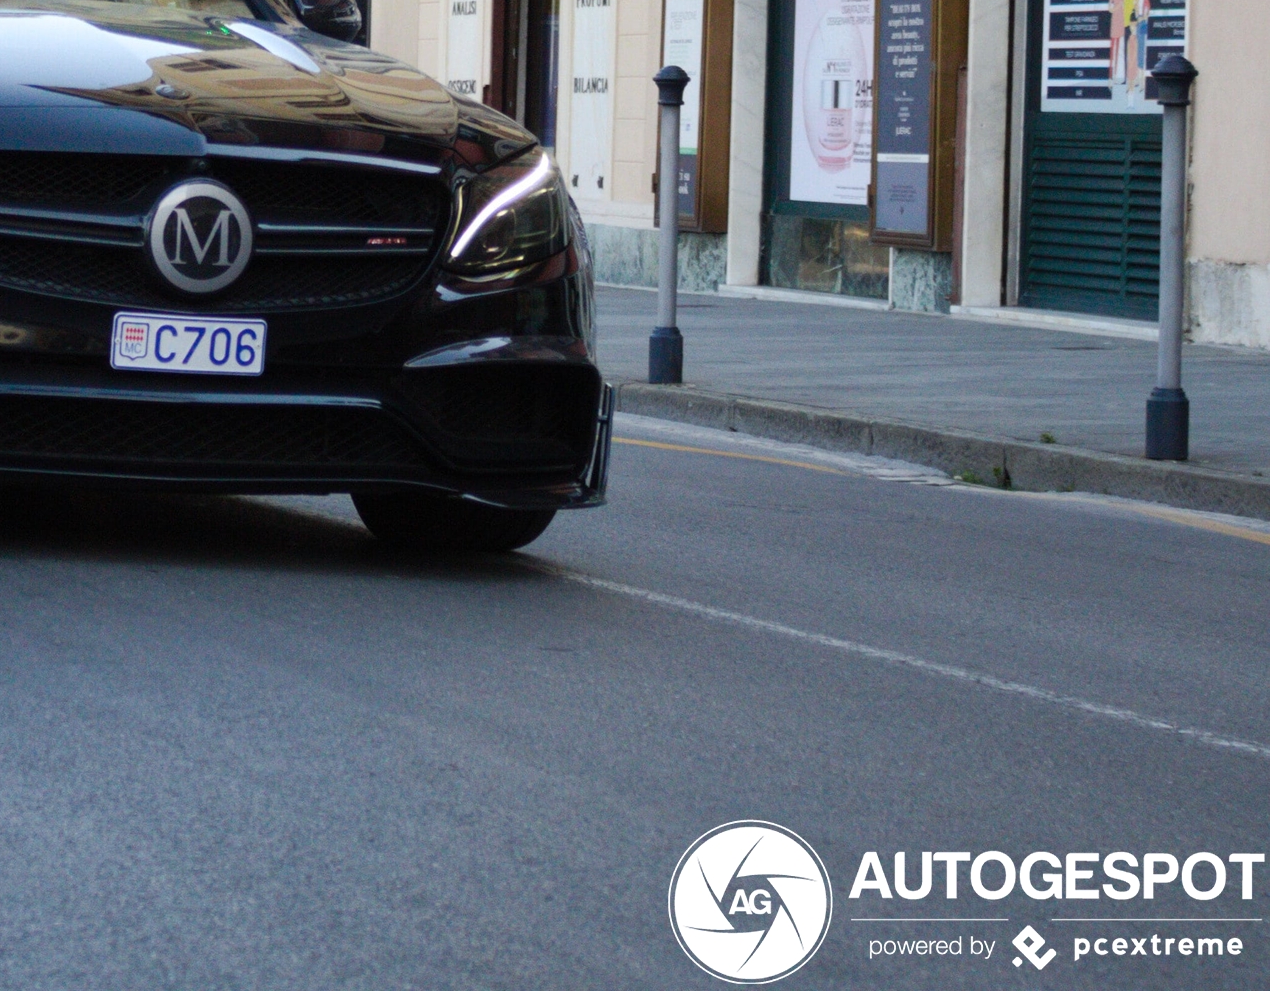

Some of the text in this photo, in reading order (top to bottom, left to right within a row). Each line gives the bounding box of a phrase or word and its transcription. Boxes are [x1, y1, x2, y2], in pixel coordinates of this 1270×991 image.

[452, 0, 477, 16] ANALISI
[574, 77, 609, 94] BILANCIA
[170, 208, 233, 267] M
[124, 324, 258, 367] MC C706
